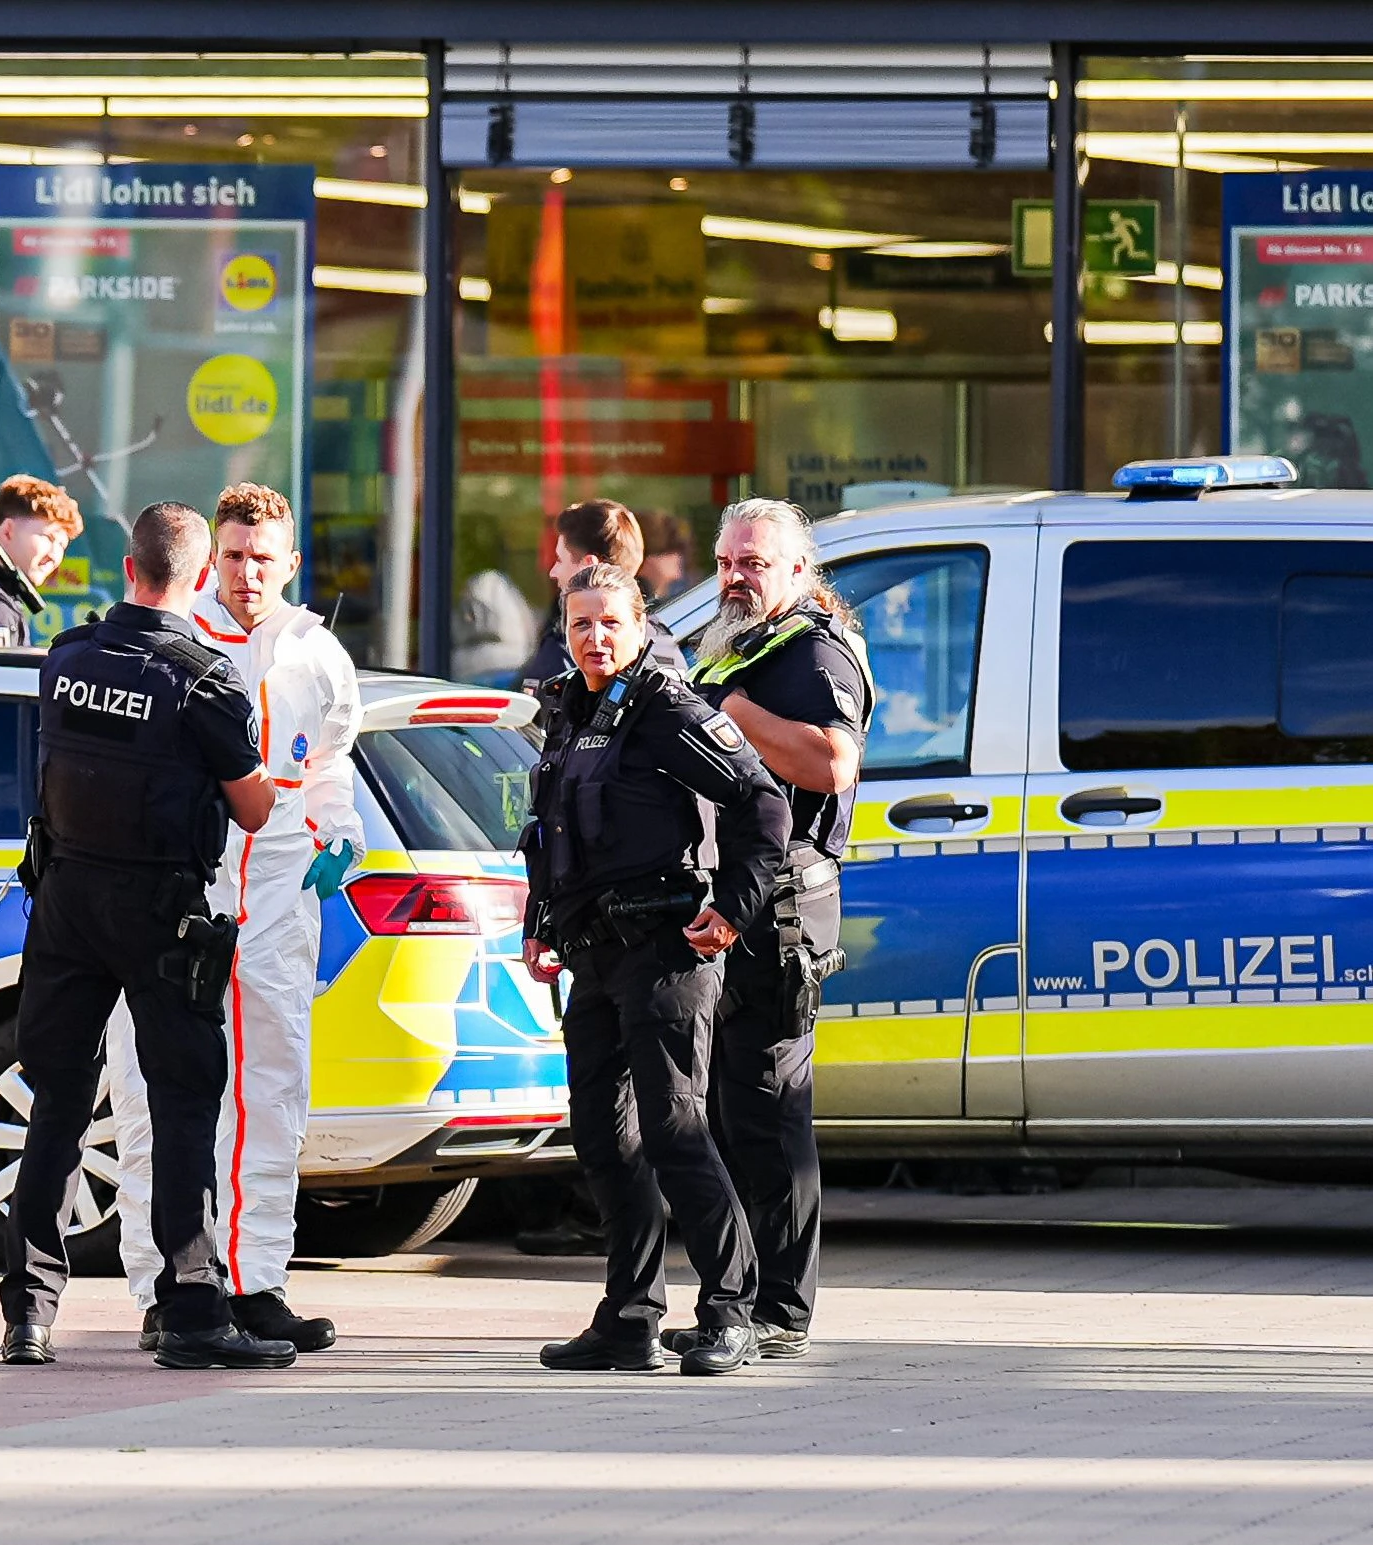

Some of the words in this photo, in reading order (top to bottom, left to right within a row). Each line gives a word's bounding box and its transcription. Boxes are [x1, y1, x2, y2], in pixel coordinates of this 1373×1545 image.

[35, 176, 95, 205] Lidl
[101, 176, 185, 206] lohnt
[192, 177, 256, 206] sich
[1282, 183, 1342, 213] Lidl
[48, 276, 177, 300] PARKSIDE
[195, 394, 269, 415] lidl.de
[53, 676, 153, 720] POLIZEI
[575, 735, 611, 751] POLIZEI
[1092, 934, 1335, 989] POLIZEI
